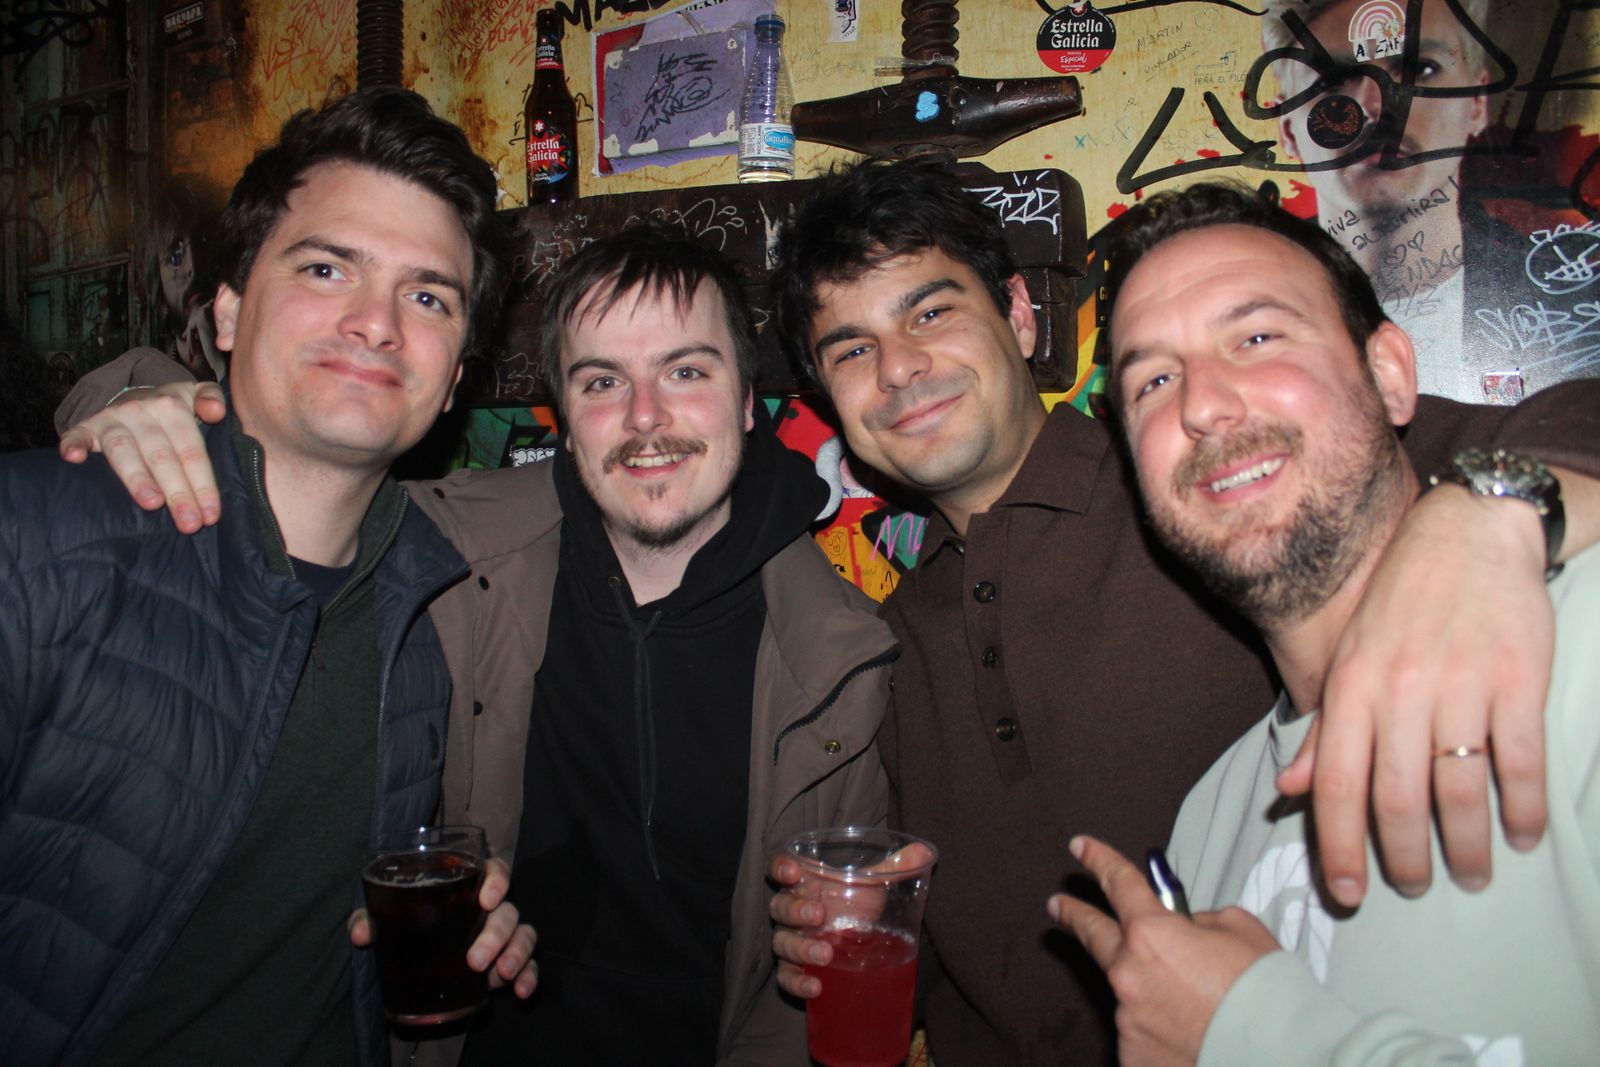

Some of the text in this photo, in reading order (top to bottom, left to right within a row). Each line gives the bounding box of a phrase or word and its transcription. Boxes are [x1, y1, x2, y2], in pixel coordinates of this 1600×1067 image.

[1050, 18, 1104, 33] Estrella
[1051, 34, 1100, 49] Galicia
[1060, 53, 1088, 65] Especial
[1230, 69, 1248, 82] PILÓ
[526, 138, 560, 153] Estrella
[527, 149, 558, 164] Galicia
